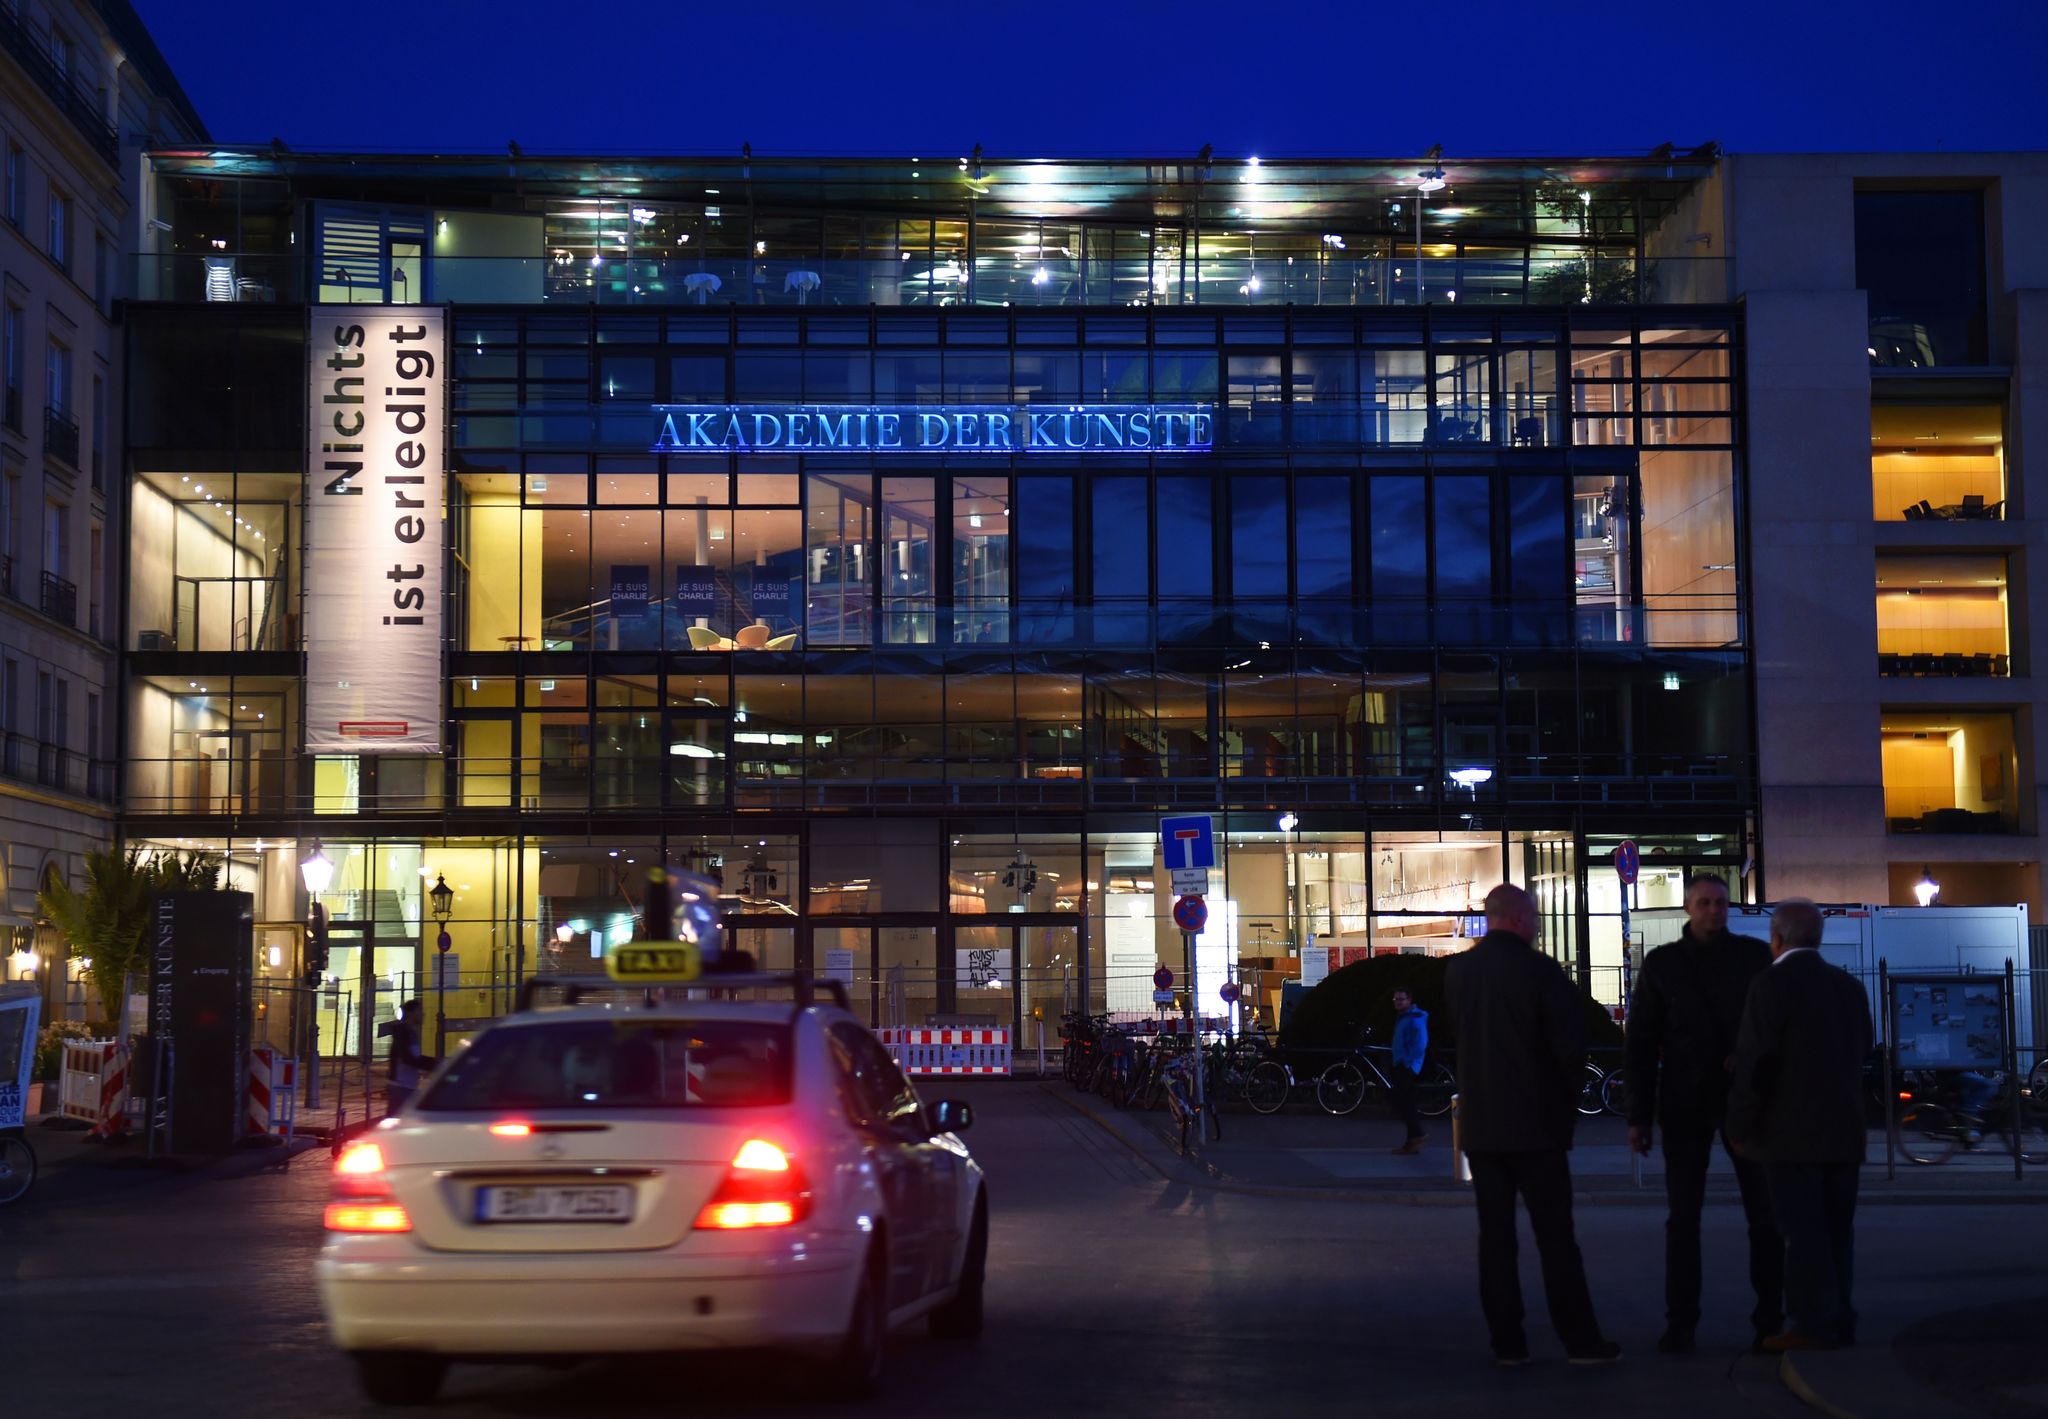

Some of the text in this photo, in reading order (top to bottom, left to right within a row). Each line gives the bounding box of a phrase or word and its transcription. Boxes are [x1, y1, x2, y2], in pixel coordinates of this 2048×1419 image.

[323, 324, 366, 497] Nichts
[654, 406, 1213, 448] AKADEMIE DER KÜNSTE
[383, 324, 435, 626] ist erledigt
[612, 583, 648, 592] JE SUIS
[678, 583, 714, 592] JE SUIS
[753, 583, 789, 592] JE SUIS
[612, 592, 648, 601] CHARLIE
[678, 592, 714, 601] CHARLIE
[753, 592, 789, 601] CHARLIE
[154, 899, 174, 975] KÜNSTE
[968, 949, 999, 961] KUNST
[622, 952, 682, 971] TAXI
[199, 967, 230, 976] Eingang
[970, 972, 999, 988] ALLE
[0, 1095, 20, 1107] AN
[0, 1107, 20, 1116] OUP
[0, 1115, 20, 1124] RLIN
